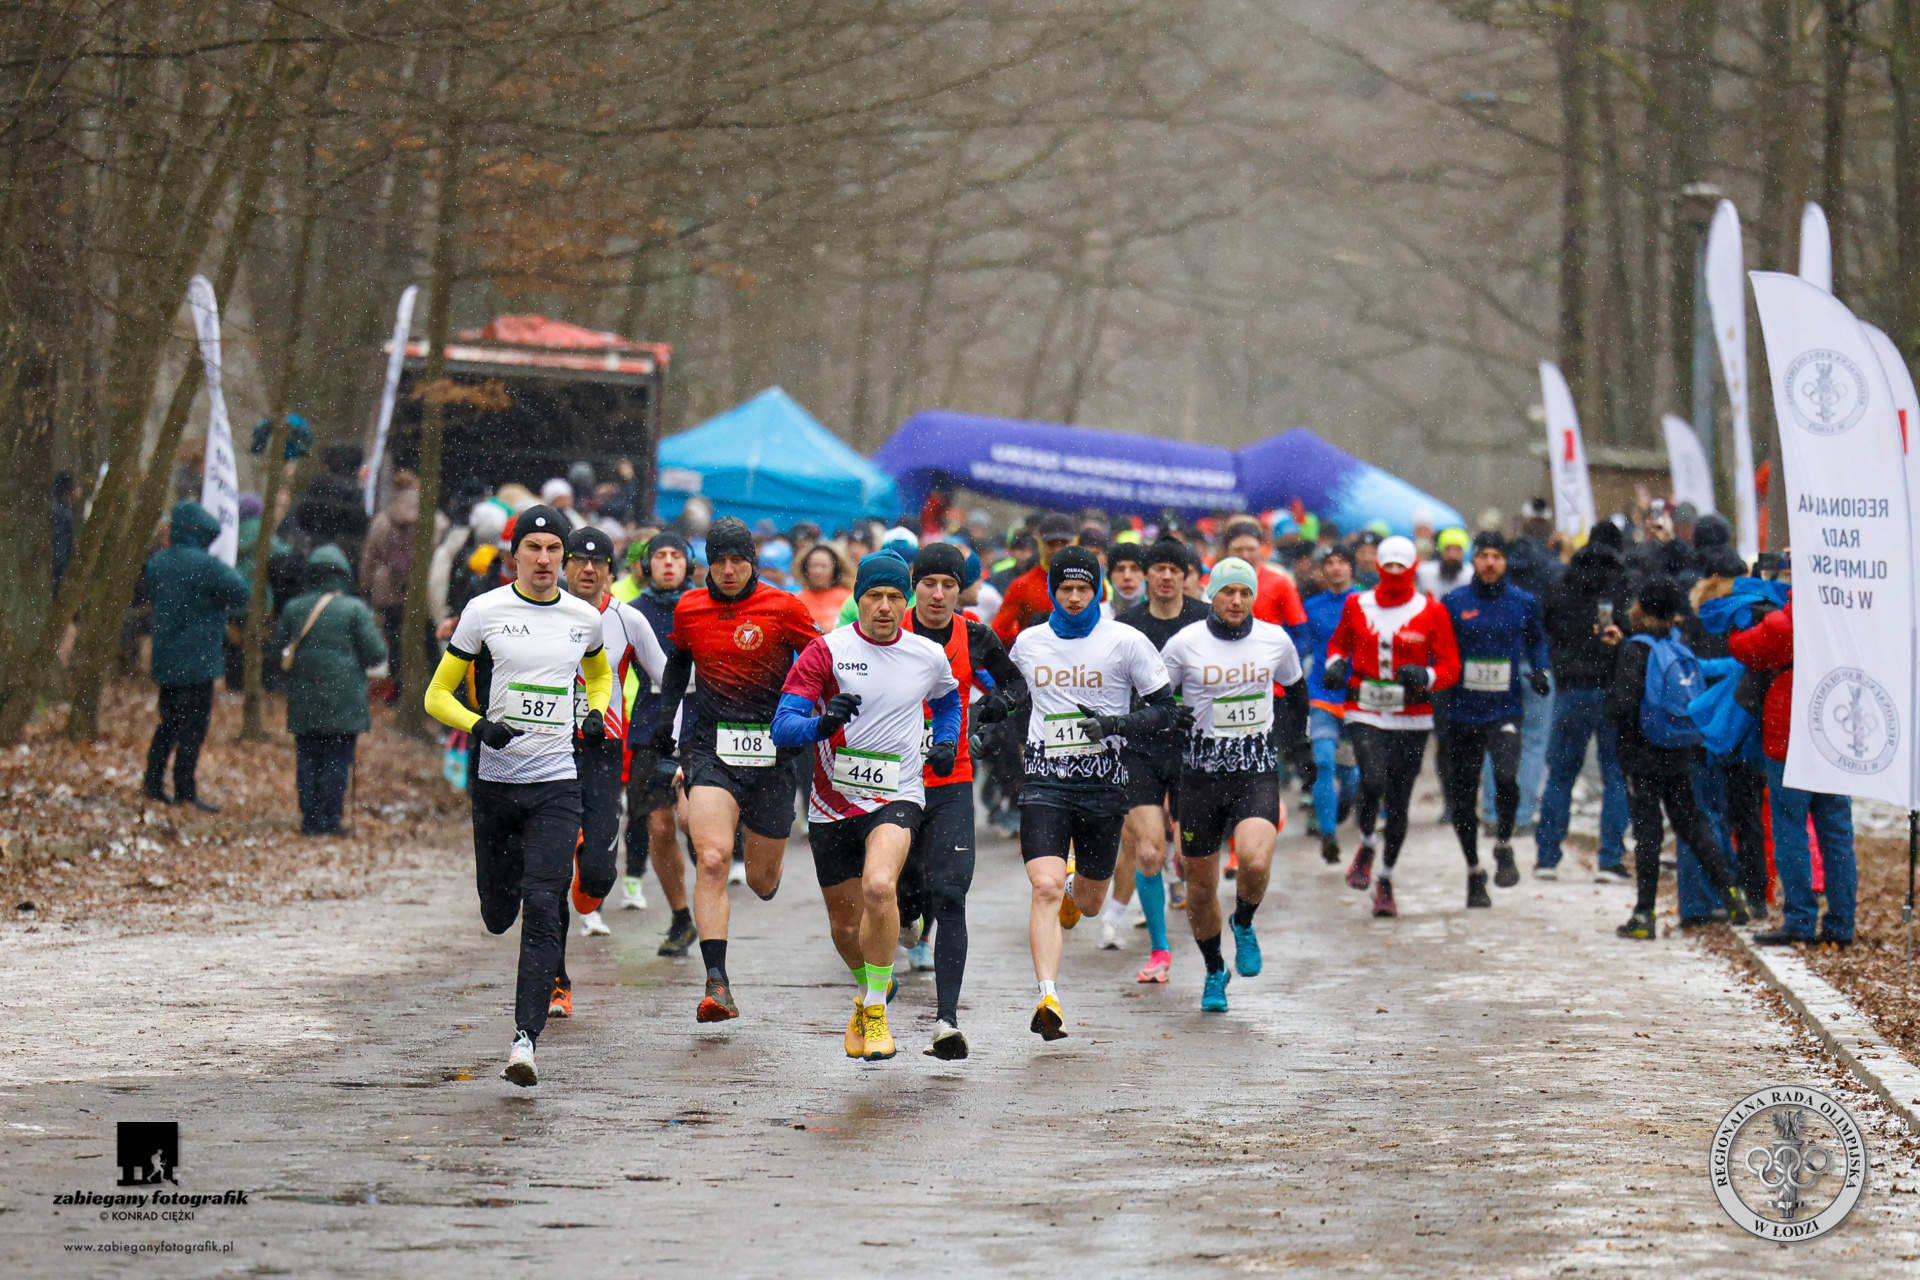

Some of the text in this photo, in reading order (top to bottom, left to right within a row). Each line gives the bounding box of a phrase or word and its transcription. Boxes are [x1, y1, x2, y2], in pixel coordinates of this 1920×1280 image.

[837, 662, 868, 671] OSMO
[1203, 662, 1270, 686] Delia
[1034, 664, 1103, 688] Delia
[521, 699, 557, 718] 587
[574, 698, 590, 713] 73
[1227, 706, 1256, 722] 415
[732, 736, 762, 751] 108
[848, 765, 884, 784] 446
